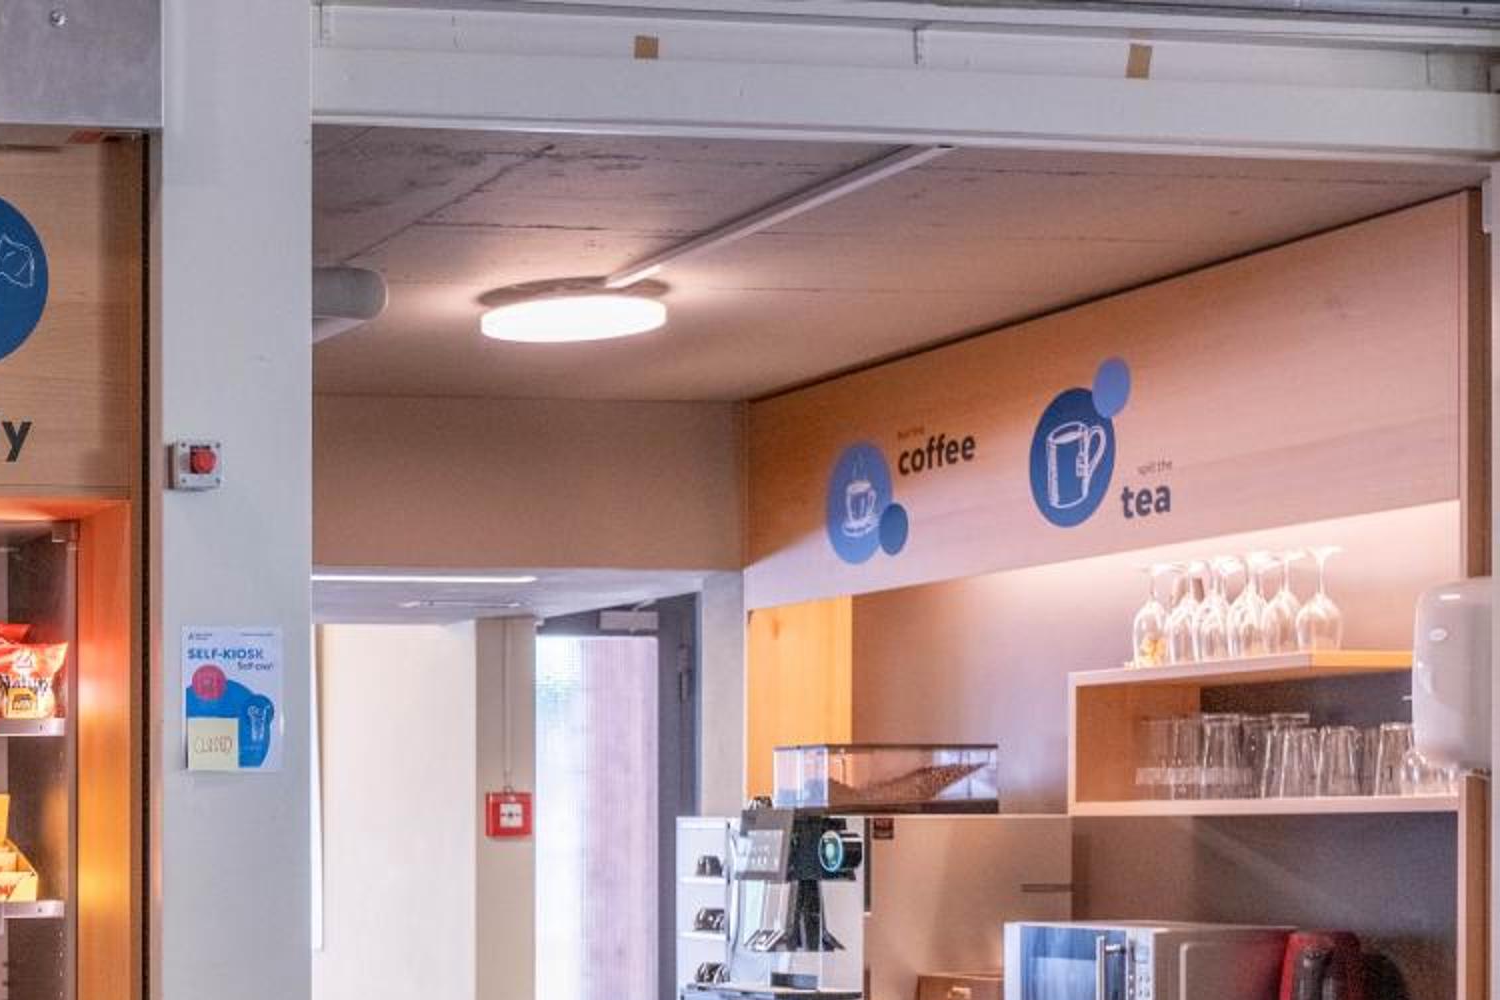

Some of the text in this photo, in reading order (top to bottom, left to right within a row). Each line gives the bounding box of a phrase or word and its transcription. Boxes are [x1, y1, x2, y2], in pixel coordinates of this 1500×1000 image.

[898, 433, 976, 476] coffee
[1121, 486, 1171, 519] tea
[187, 648, 265, 660] SELF-KIOSK
